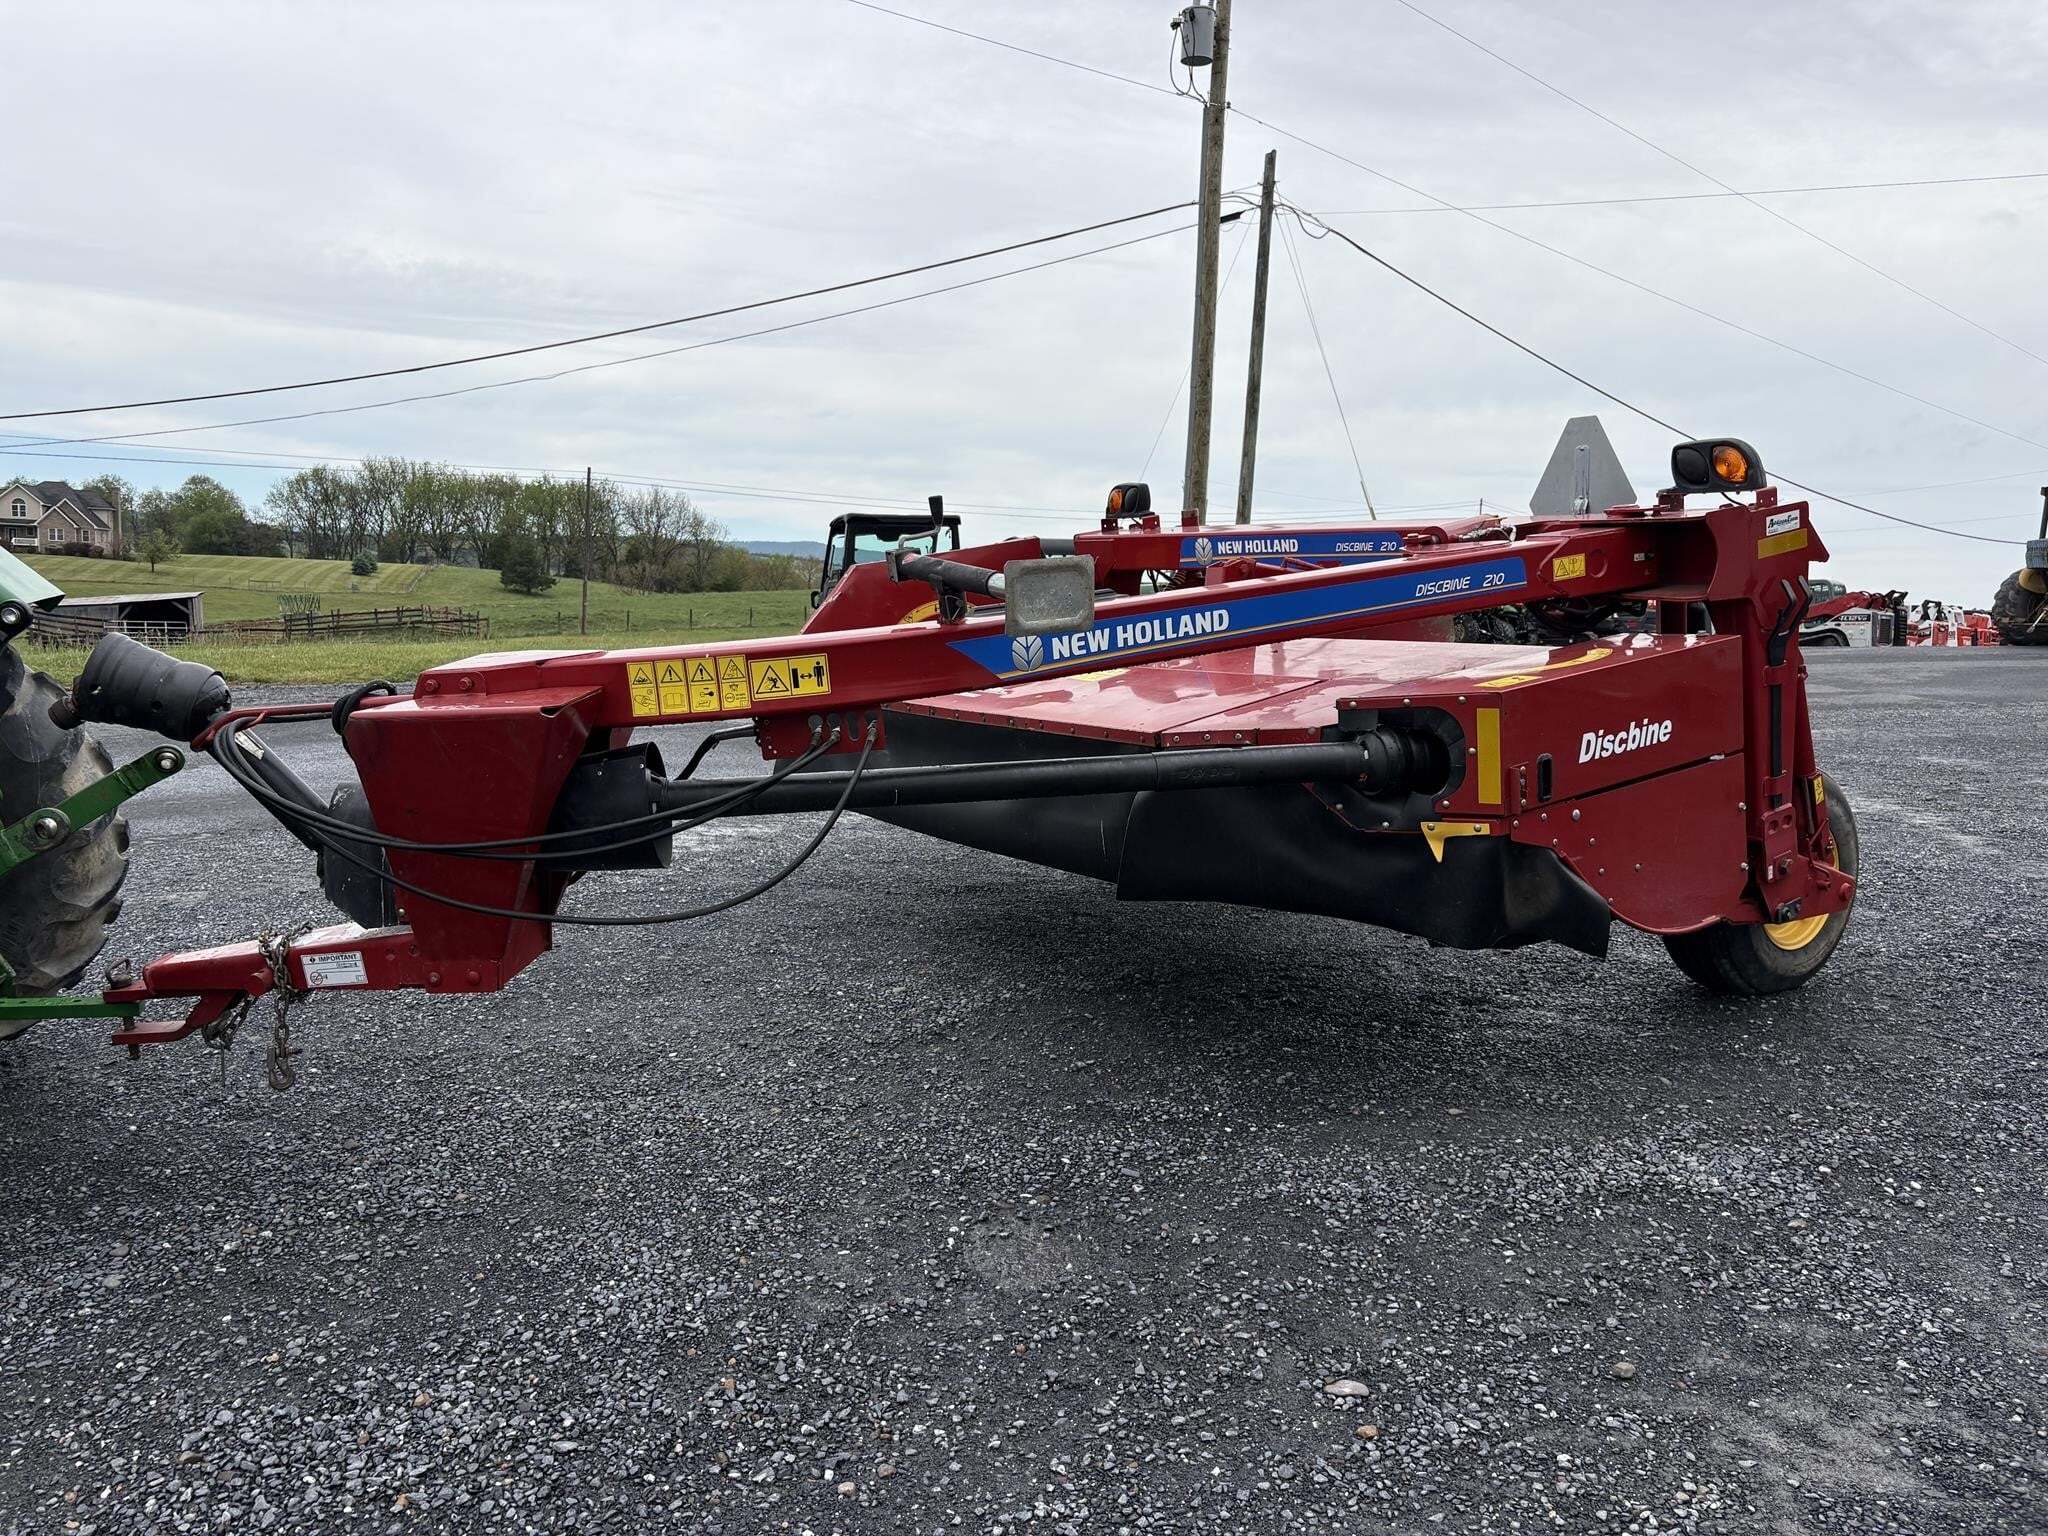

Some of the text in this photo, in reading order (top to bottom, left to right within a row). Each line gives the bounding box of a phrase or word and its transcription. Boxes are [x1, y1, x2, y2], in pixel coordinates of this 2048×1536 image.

[1217, 539, 1299, 554] NEW HOLLAND
[1335, 541, 1397, 552] DISCBINE 210
[1415, 572, 1505, 597] DISCBINE 210
[1051, 609, 1230, 660] NEW HOLLAND
[1578, 718, 1673, 764] Discbine
[319, 954, 357, 962] IMPORTANT
